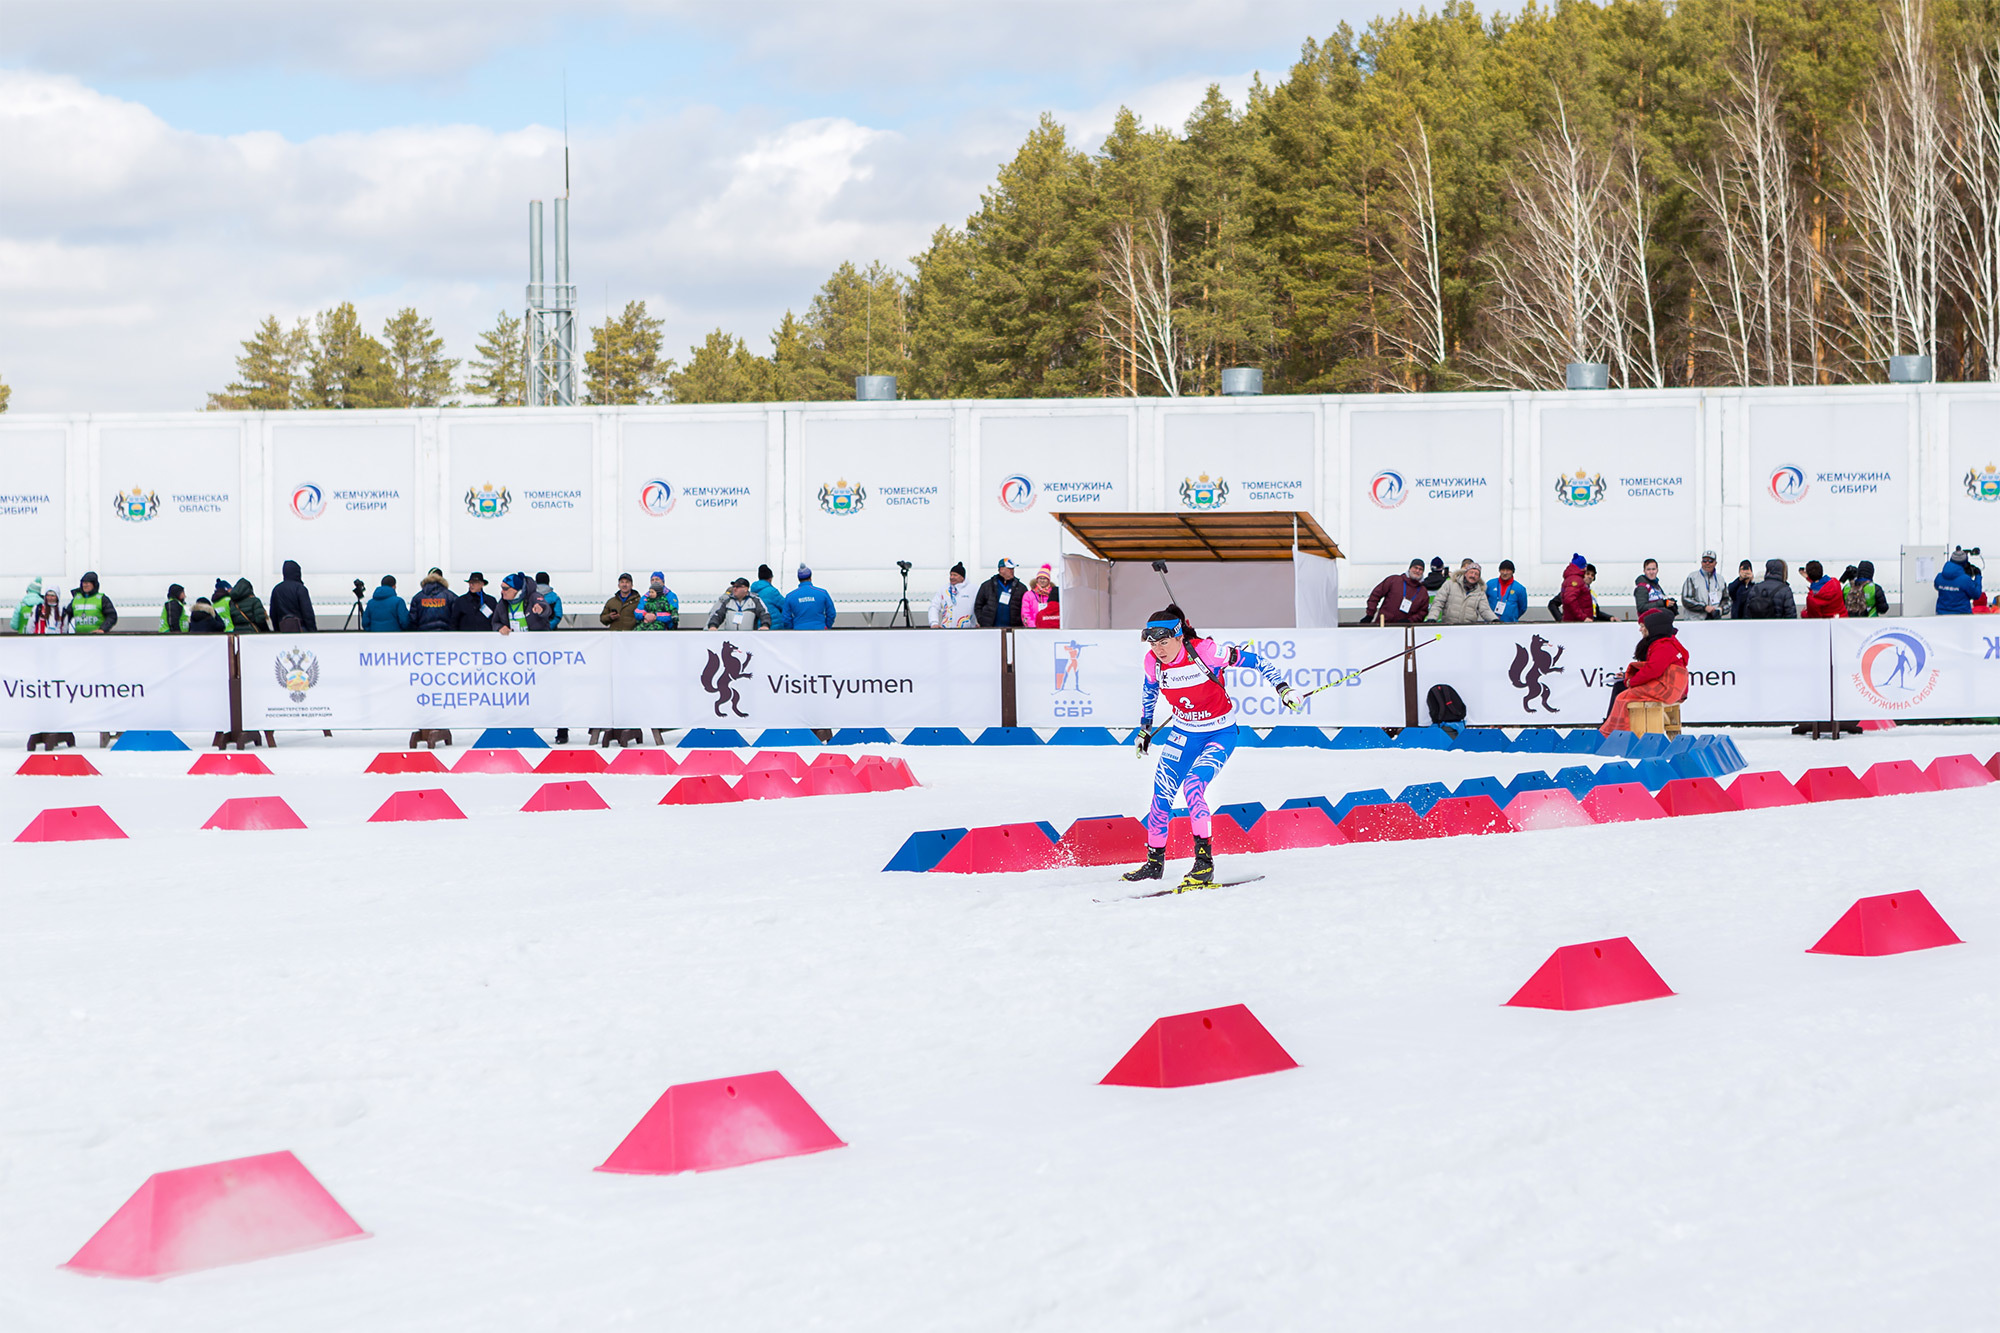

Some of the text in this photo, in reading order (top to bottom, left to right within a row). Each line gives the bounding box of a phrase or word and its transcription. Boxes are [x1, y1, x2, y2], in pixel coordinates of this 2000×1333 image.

[1415, 477, 1488, 487] ЖЕМЧУЖИНА
[1619, 477, 1683, 487] ТЮМЕНСКАЯ
[1816, 472, 1892, 482] ЖЕМЧУЖИНА
[1043, 482, 1114, 491] ЖЕМЧУЖИНА
[1241, 481, 1303, 490] ТЮМЕНСКАЯ
[1830, 484, 1878, 494] СИБИРИ
[333, 490, 400, 499] ЖЕМЧУЖИНА
[523, 490, 582, 499] ТЮМЕНСКАЯ
[682, 486, 751, 496] ЖЕМЧУЖИНА
[878, 486, 938, 496] ТЮМЕНСКАЯ
[1248, 491, 1295, 501] ОБЛАСТЬ
[1428, 489, 1474, 499] СИБИРИ
[1627, 488, 1675, 497] ОБЛАСТЬ
[171, 493, 229, 503] ТЮМЕНСКАЯ
[695, 498, 738, 508] СИБИРИ
[885, 497, 931, 506] ОБЛАСТЬ
[1056, 493, 1101, 503] СИБИРИ
[178, 504, 222, 513] ОБЛАСТЬ
[345, 502, 388, 511] СИБИРИ
[530, 500, 575, 510] ОБЛАСТЬ
[359, 650, 587, 667] МИНИСТЕРСТВО СПОРТА
[409, 667, 536, 687] РОССИЙСКОЙ
[2, 679, 145, 704] VisitTyumen
[767, 673, 913, 700] VisitTyumen
[1851, 668, 1941, 711] ЖЕМЧУЖИНА СИБИРИ
[416, 691, 530, 710] ФЕДЕРАЦИИ
[1053, 706, 1094, 718] СБР
[1174, 705, 1212, 721] ТЮМЕНЬ
